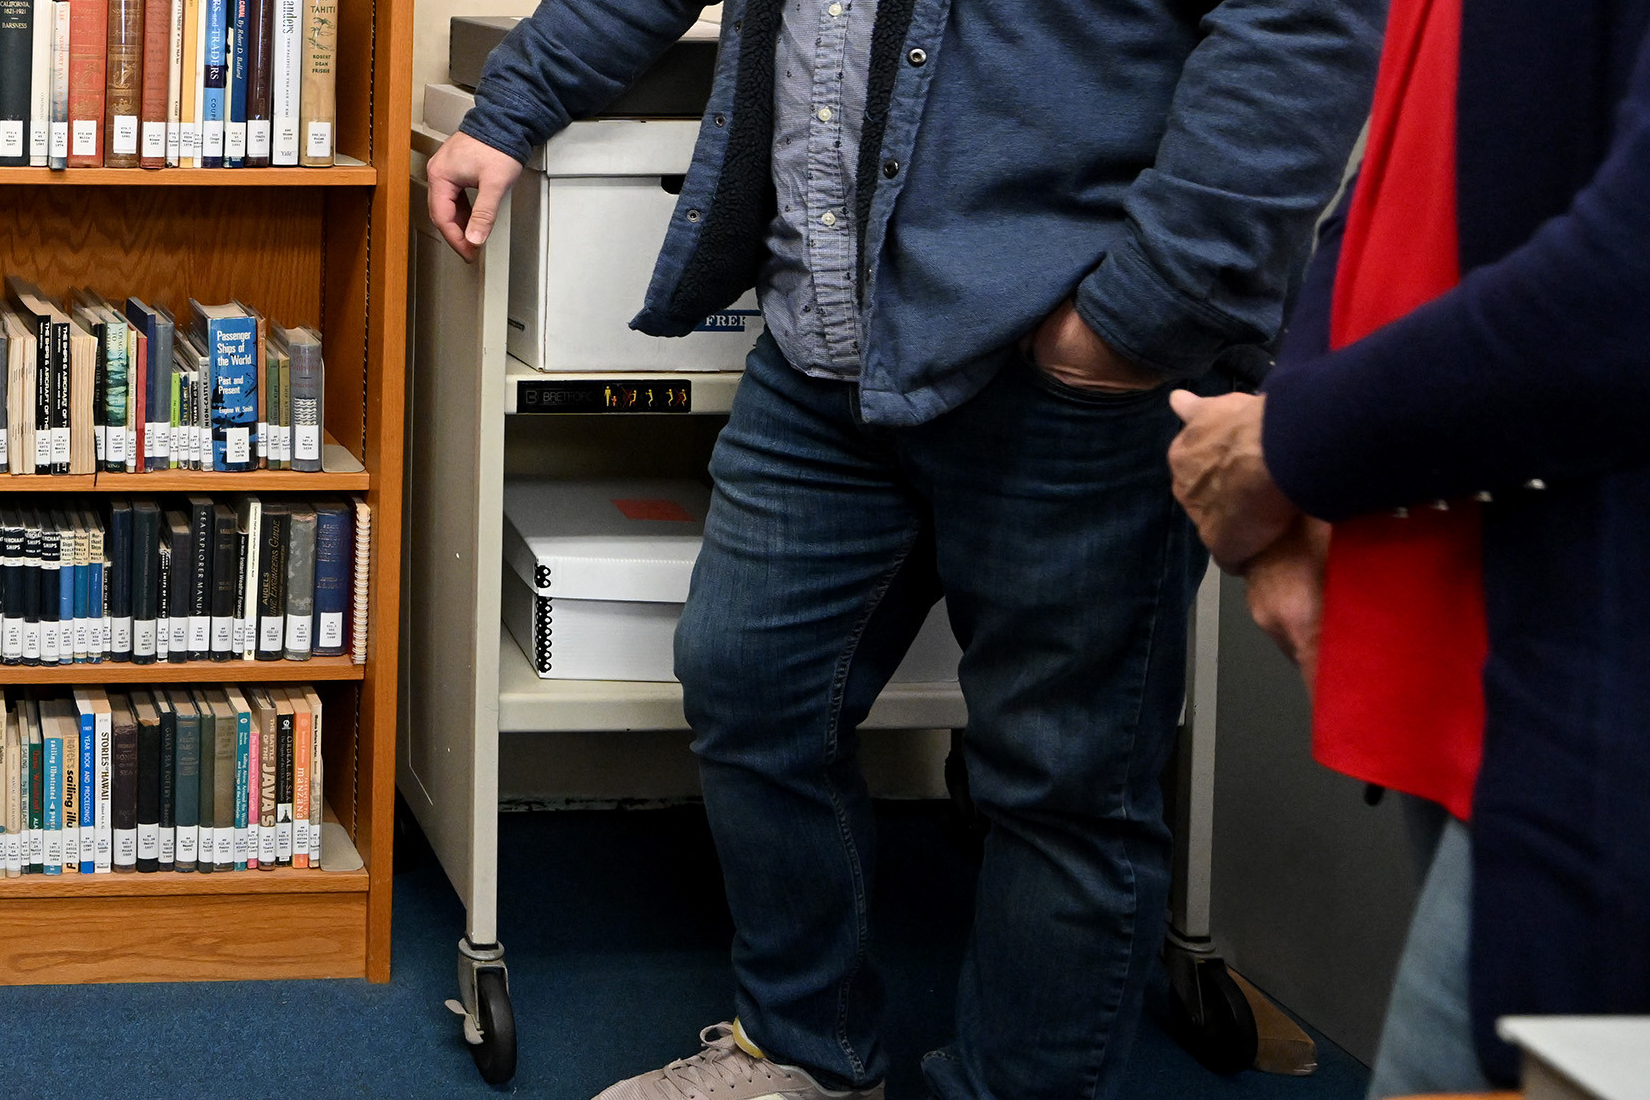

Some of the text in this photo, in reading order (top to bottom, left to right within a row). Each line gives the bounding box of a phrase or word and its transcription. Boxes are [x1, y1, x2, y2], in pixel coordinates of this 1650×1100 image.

[311, 6, 336, 14] TAHITI
[209, 28, 221, 81] TRADERS
[217, 331, 251, 342] Passenger
[217, 343, 245, 356] Ships of
[218, 354, 252, 366] the World
[218, 376, 244, 385] Past and
[218, 385, 241, 394] Present
[264, 735, 268, 744] OF
[101, 732, 110, 800] STORIES HAWAII
[261, 764, 276, 812] JAVA
[83, 786, 91, 823] PROCEEDINGS
